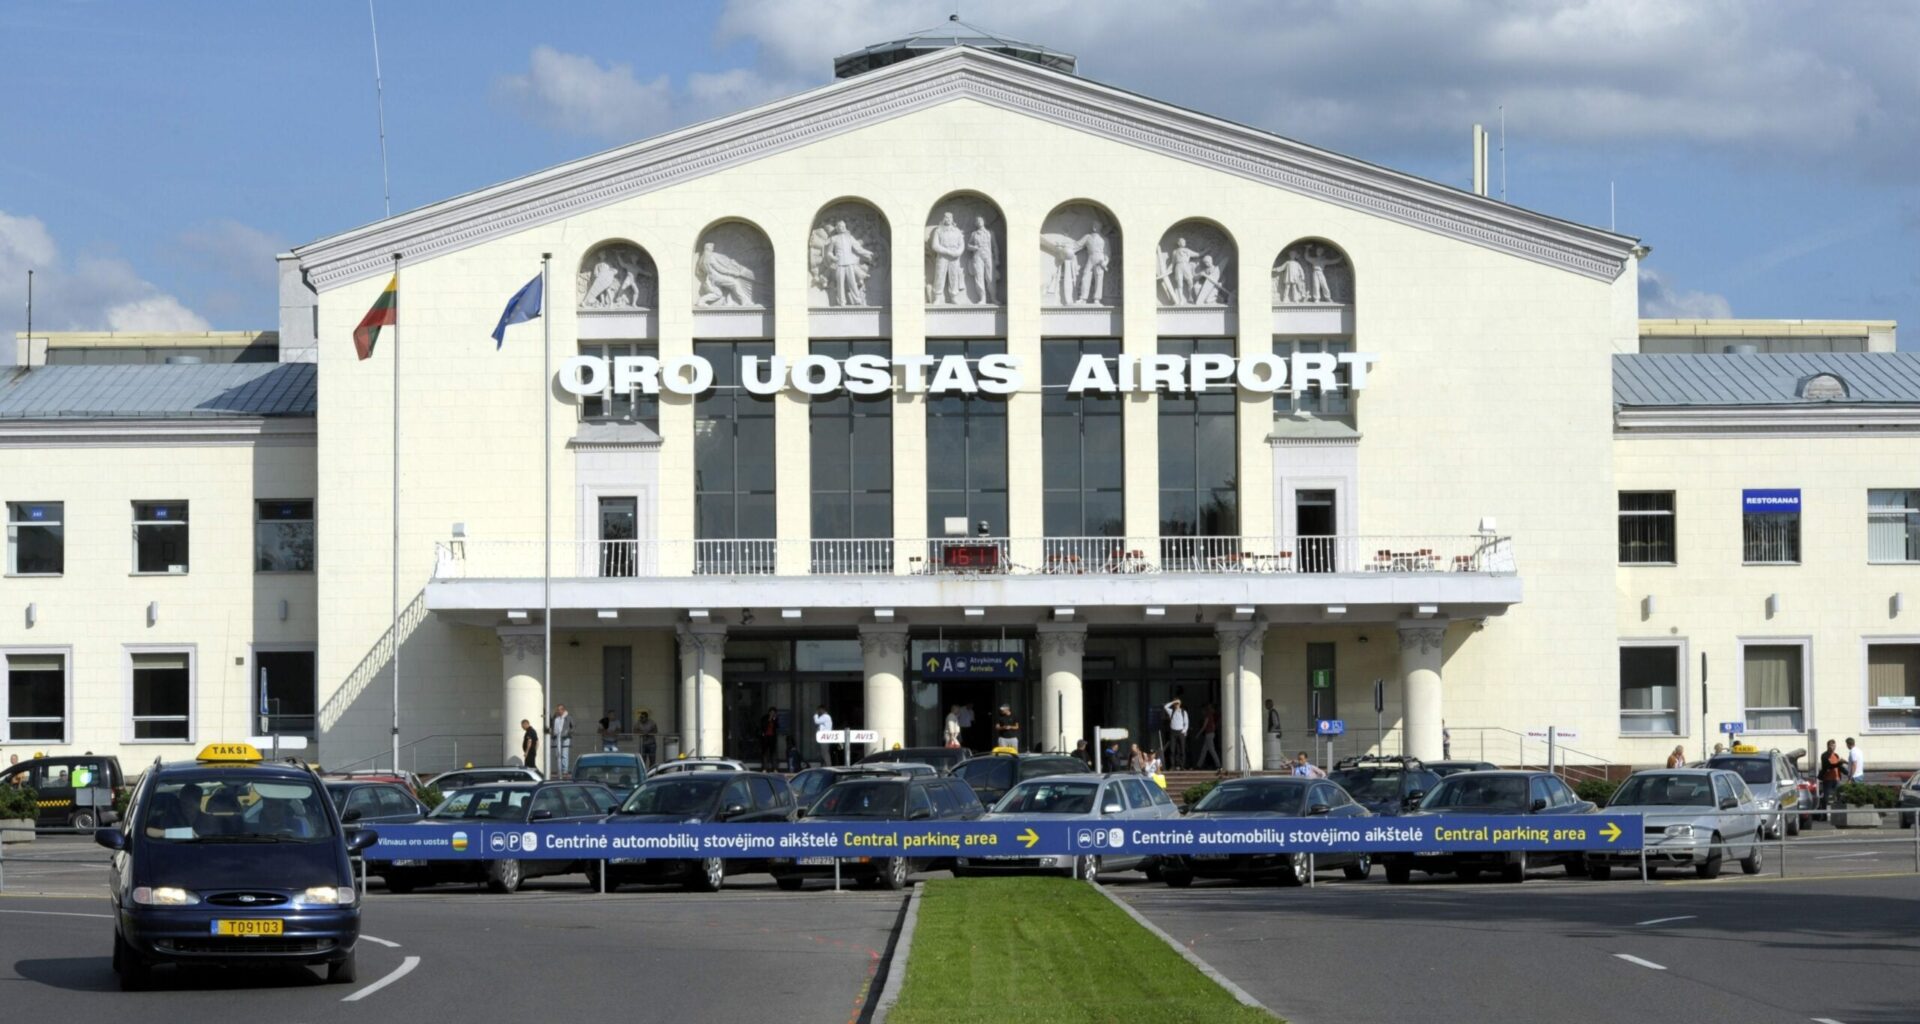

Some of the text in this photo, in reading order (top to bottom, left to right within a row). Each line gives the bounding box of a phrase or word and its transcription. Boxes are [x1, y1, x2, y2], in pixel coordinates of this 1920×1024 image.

[559, 351, 1379, 394] ORO UOSTAS AIRPORT
[1745, 496, 1800, 505] RESTORANAS
[820, 732, 840, 741] AVIS
[854, 732, 874, 741] AVIS
[211, 745, 248, 755] TAKSI
[1132, 829, 1194, 845] Centrinė
[1198, 828, 1285, 847] automobilių
[1289, 827, 1361, 847] stovėjimo
[1364, 826, 1424, 842] aikštelė
[1434, 826, 1489, 841] Central
[1493, 825, 1550, 844] parking
[1553, 829, 1586, 841] area
[377, 837, 408, 846] Vilniaus
[423, 838, 449, 846] uostas
[545, 833, 608, 849] Centrinė
[612, 833, 699, 852] automobilių
[703, 833, 775, 852] stovėjimo
[779, 831, 839, 848] aikštelė
[843, 831, 898, 847] Central
[903, 831, 961, 850] parking
[964, 833, 998, 846] area
[228, 921, 279, 934] T09103
